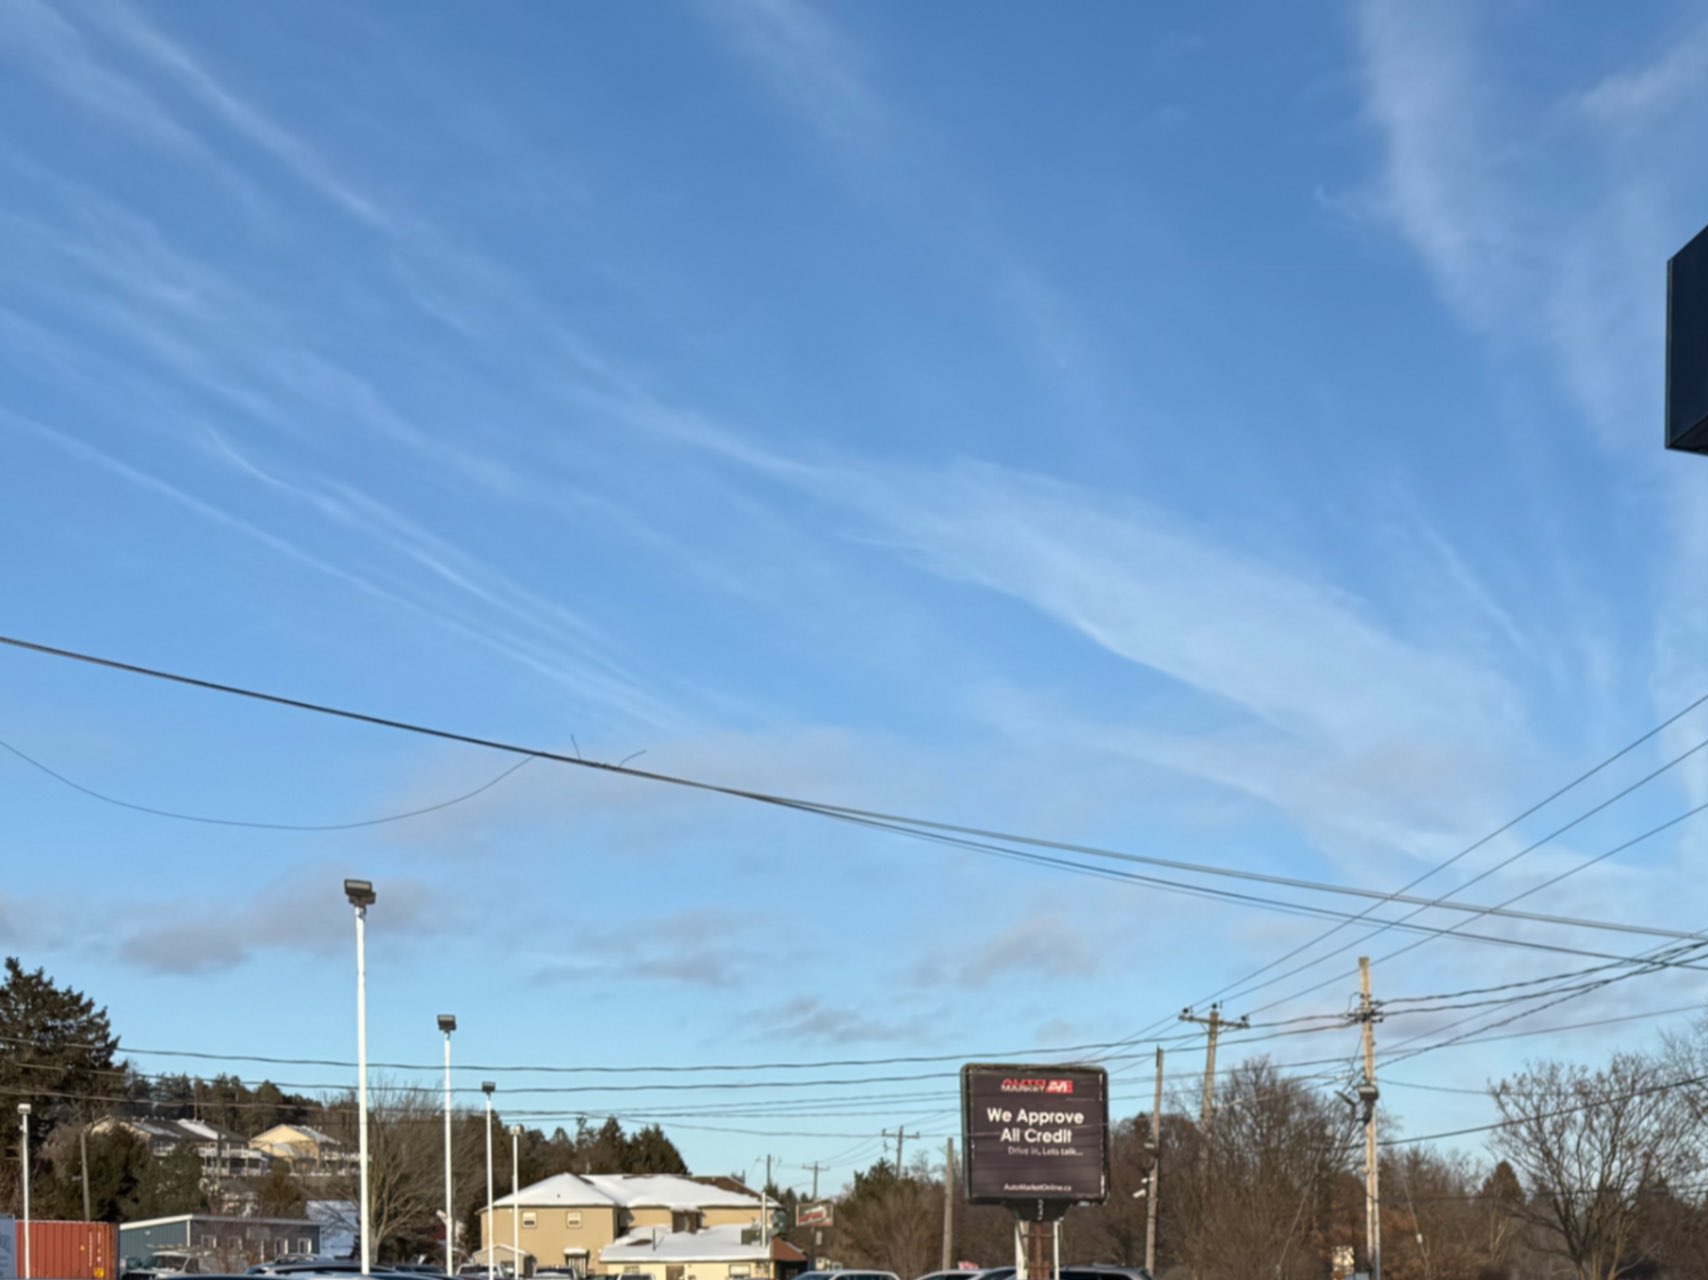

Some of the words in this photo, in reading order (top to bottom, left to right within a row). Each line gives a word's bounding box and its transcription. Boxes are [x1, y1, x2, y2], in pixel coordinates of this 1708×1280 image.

[986, 1107, 1013, 1123] We
[1016, 1108, 1085, 1127] Approve
[1000, 1128, 1021, 1143] All
[1024, 1128, 1073, 1144] Credit
